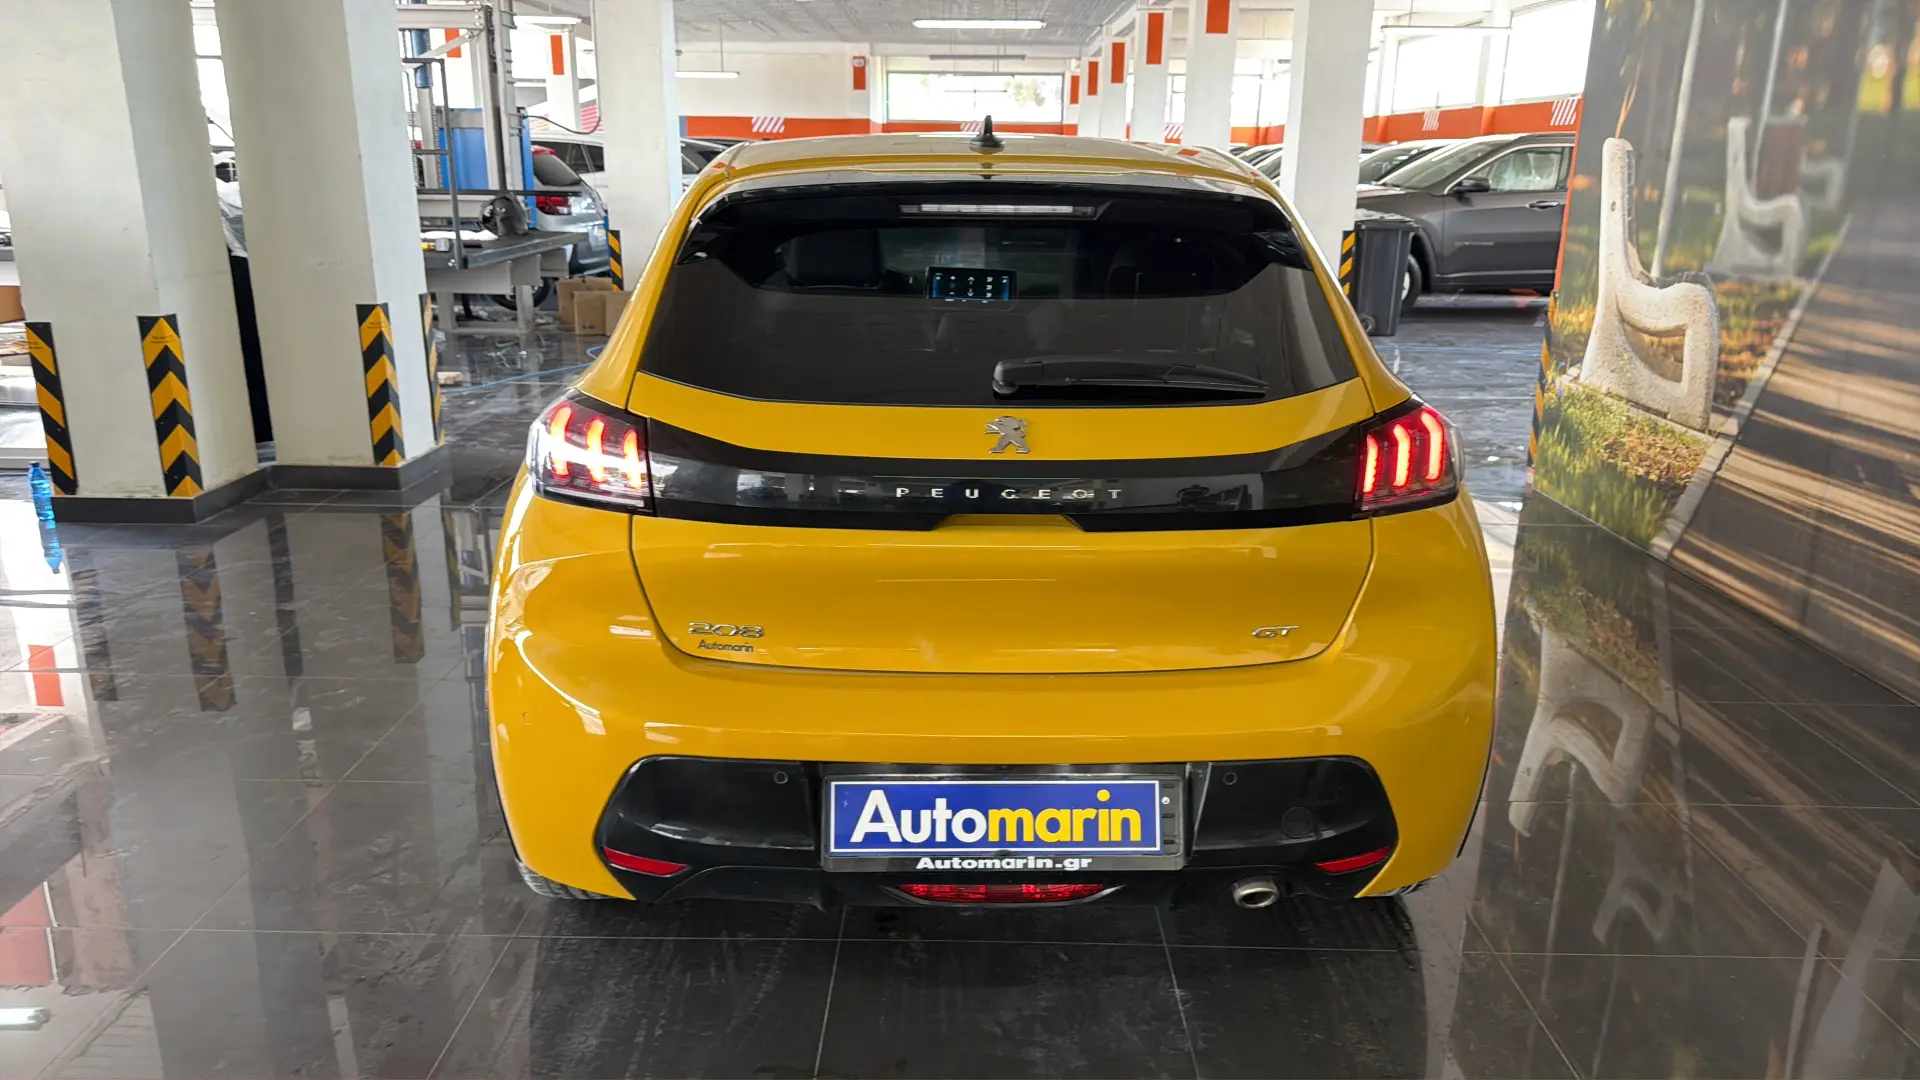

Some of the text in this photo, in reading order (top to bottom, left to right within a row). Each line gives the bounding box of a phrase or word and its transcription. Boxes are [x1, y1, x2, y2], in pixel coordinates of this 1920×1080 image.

[895, 488, 1122, 499] PEUGEOT
[687, 622, 765, 638] 208
[1250, 625, 1299, 639] GT
[698, 639, 754, 653] Automarin
[850, 789, 1142, 843] Automarin
[915, 856, 1092, 872] Automarin.gr
